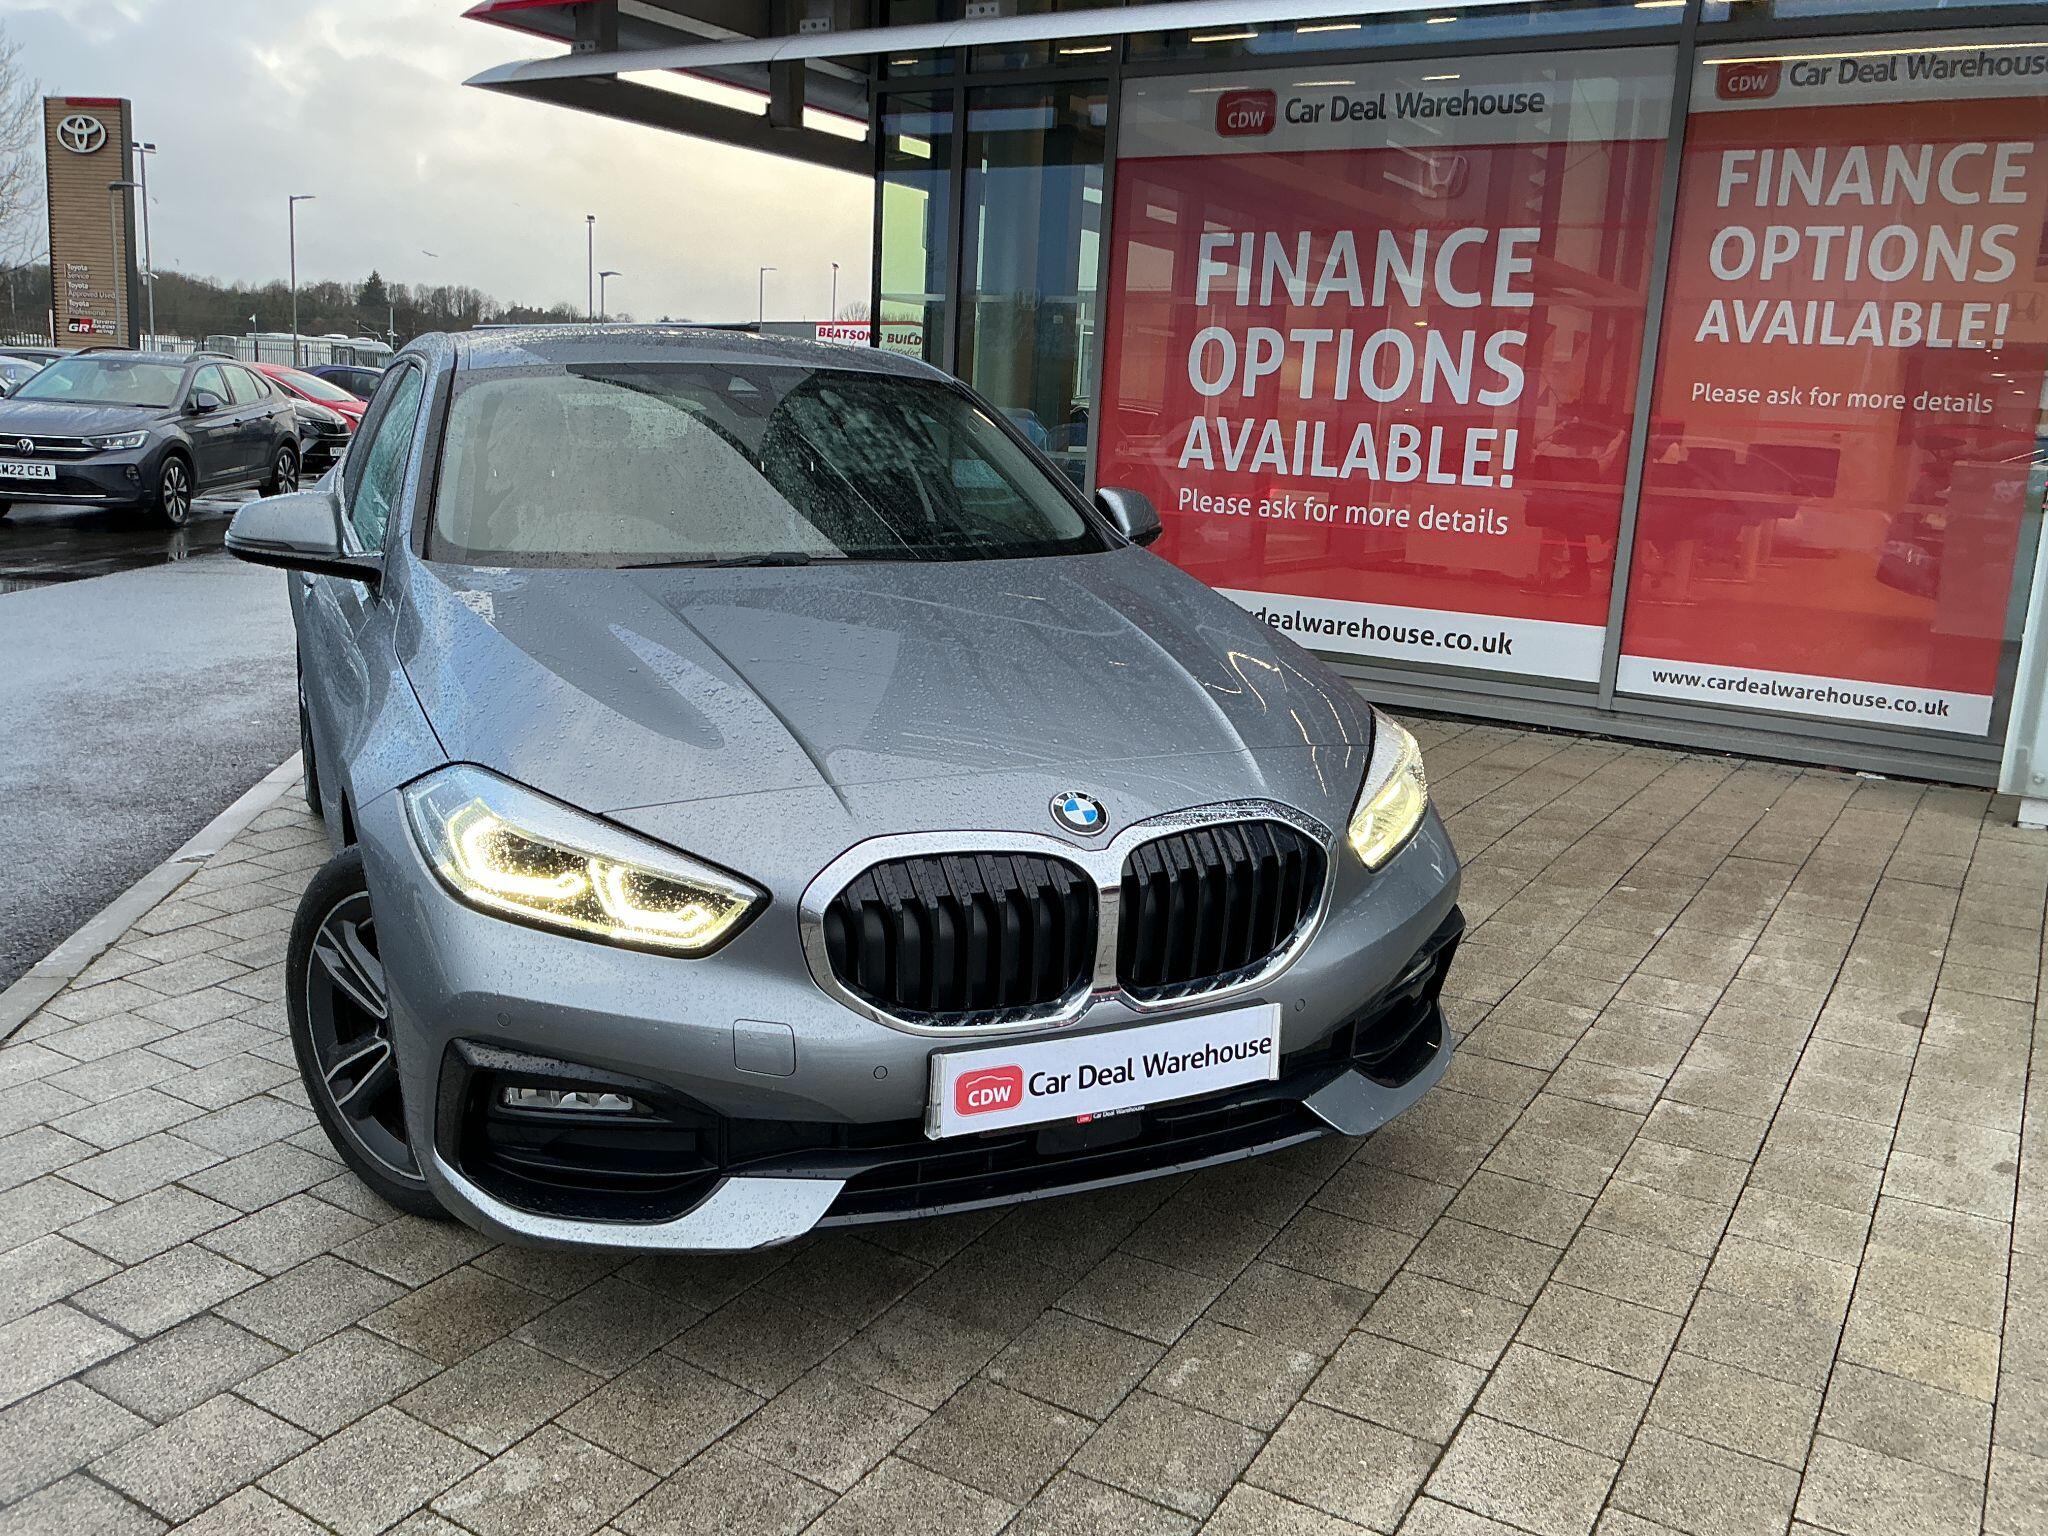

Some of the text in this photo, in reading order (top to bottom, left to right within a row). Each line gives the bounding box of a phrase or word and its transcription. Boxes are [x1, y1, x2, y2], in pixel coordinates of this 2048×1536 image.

[1727, 75, 1768, 91] CDW
[1789, 61, 1833, 87] Car
[1838, 56, 1897, 85] Deal
[1227, 111, 1266, 129] CDW
[1285, 88, 1546, 124] Car Deal Warehouse
[1717, 142, 2035, 208] FINANCE
[1195, 227, 1542, 309] FINANCE
[1709, 224, 2019, 282] OPTIONS
[68, 323, 90, 333] GR
[1694, 299, 2010, 350] AVAILABLE!
[1187, 326, 1528, 406] OPTIONS
[1692, 382, 1993, 414] Please ask for more details
[0, 464, 50, 477] M22 CEA
[1177, 415, 1519, 489] AVAILABLE!
[1178, 487, 1509, 535] Please ask for more details
[1249, 606, 1513, 655] dealwarehouse.co.uk
[1652, 668, 1950, 717] www.cardealwarehouse.co.uk
[1028, 1036, 1273, 1097] Car Deal Warehouse
[967, 1085, 1012, 1107] CDW
